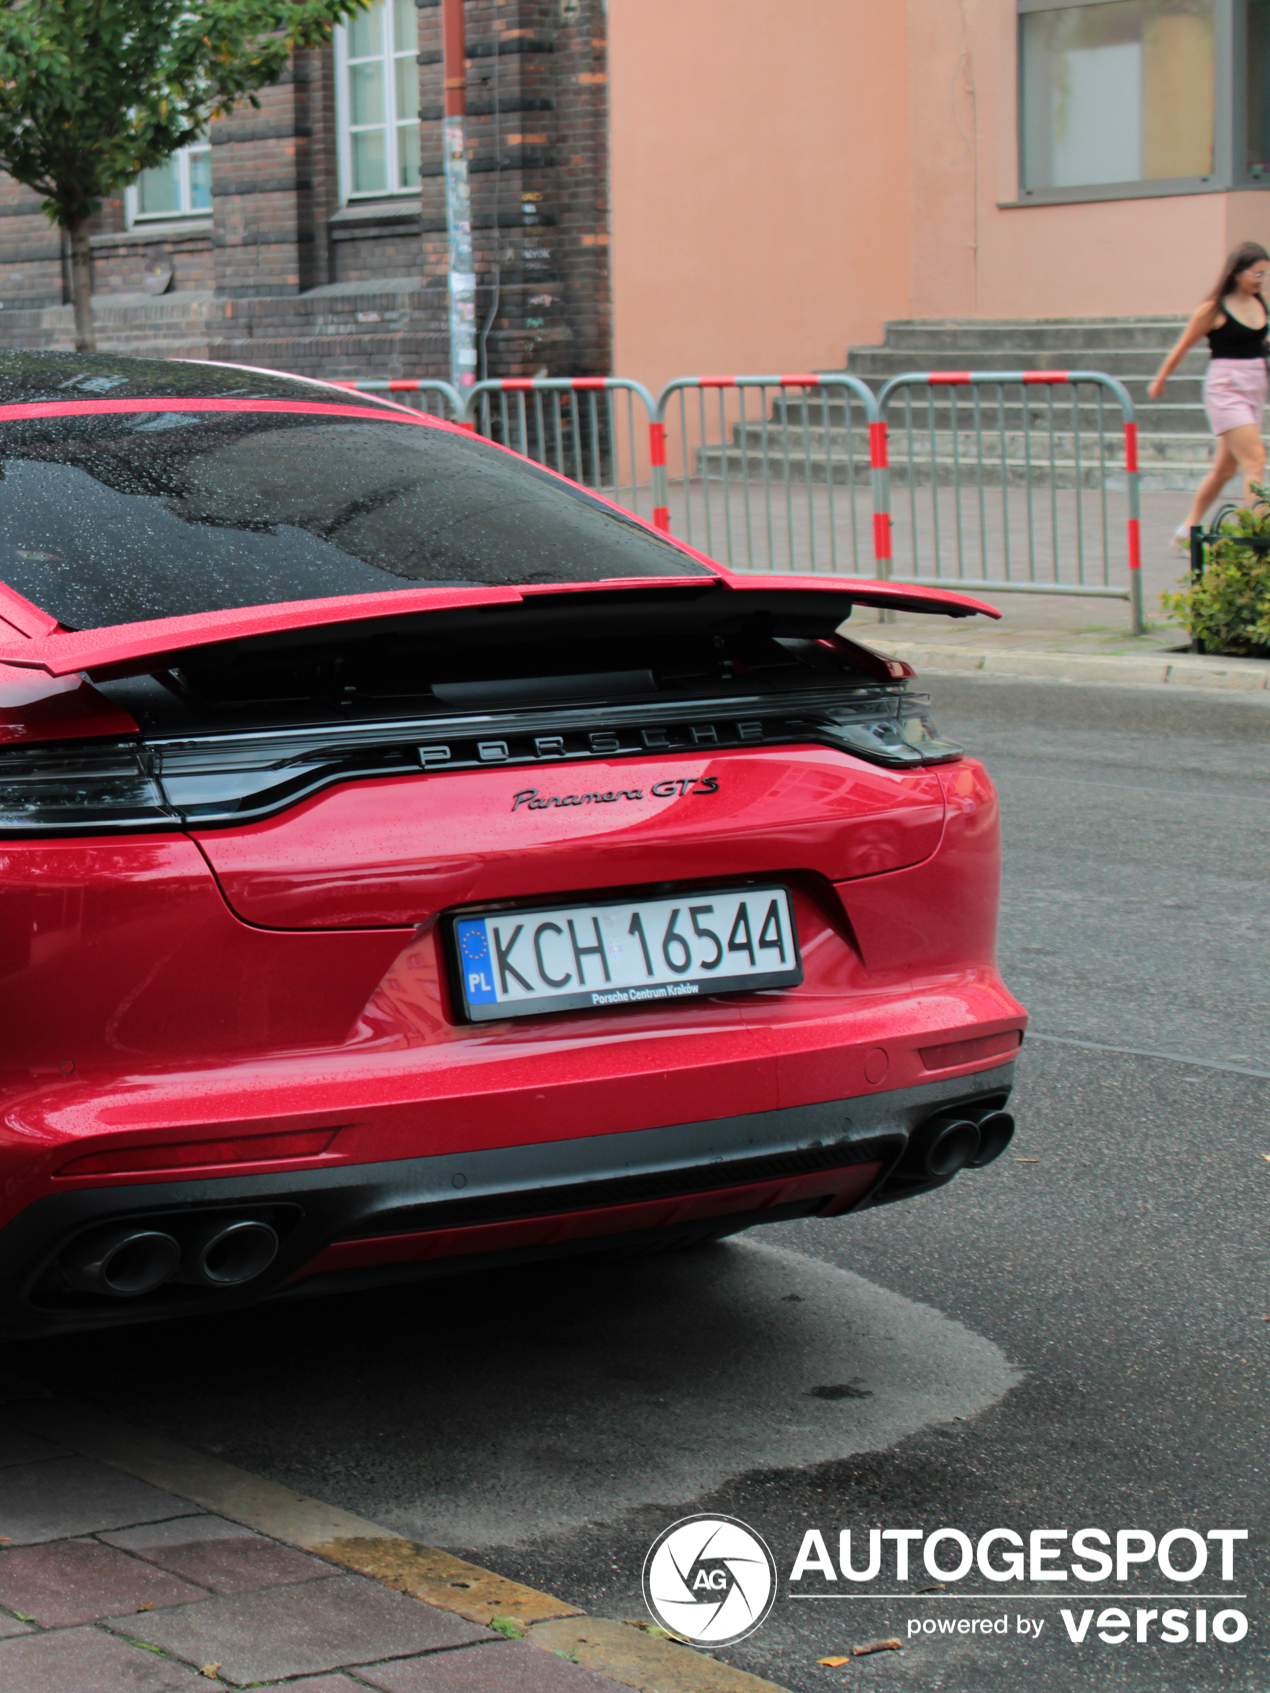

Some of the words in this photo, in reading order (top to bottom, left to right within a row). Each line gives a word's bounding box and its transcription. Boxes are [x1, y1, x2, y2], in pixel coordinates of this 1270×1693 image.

[417, 721, 764, 769] PORSCHE
[511, 787, 644, 812] Panamera
[651, 776, 720, 798] GTS
[493, 915, 612, 995] KCH
[628, 898, 788, 977] 16544
[468, 973, 492, 993] PL
[591, 990, 629, 1005] Porsche
[629, 987, 668, 1001] Centrum
[666, 982, 700, 996] Kraków
